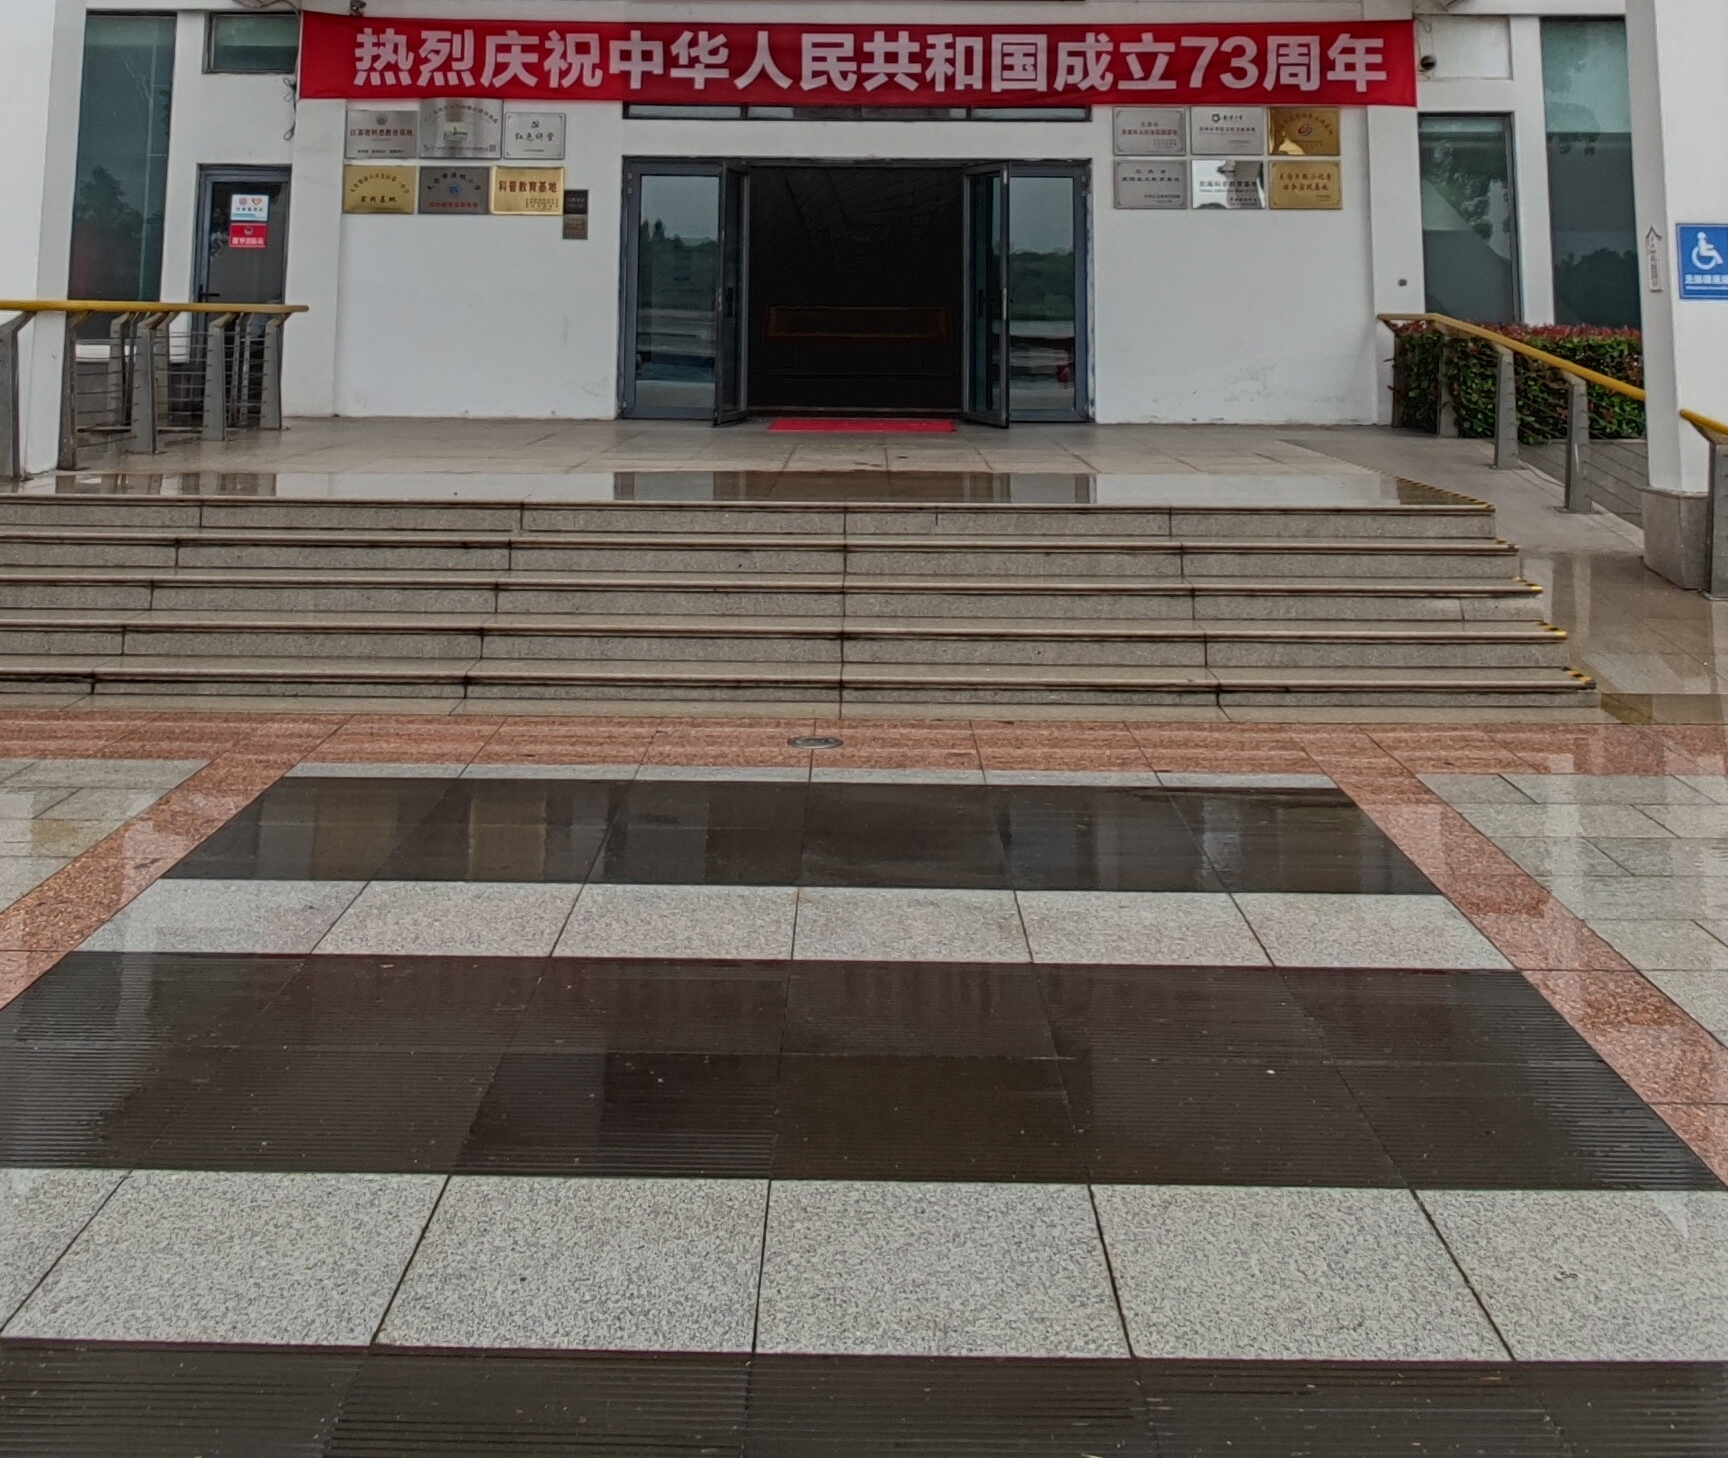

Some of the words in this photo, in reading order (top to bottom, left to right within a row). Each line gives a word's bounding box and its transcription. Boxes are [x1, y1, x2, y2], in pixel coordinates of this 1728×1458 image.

[353, 27, 1388, 93] 热烈庆祝中华人民共和国成立73周年
[498, 180, 558, 193] 科普教育基地
